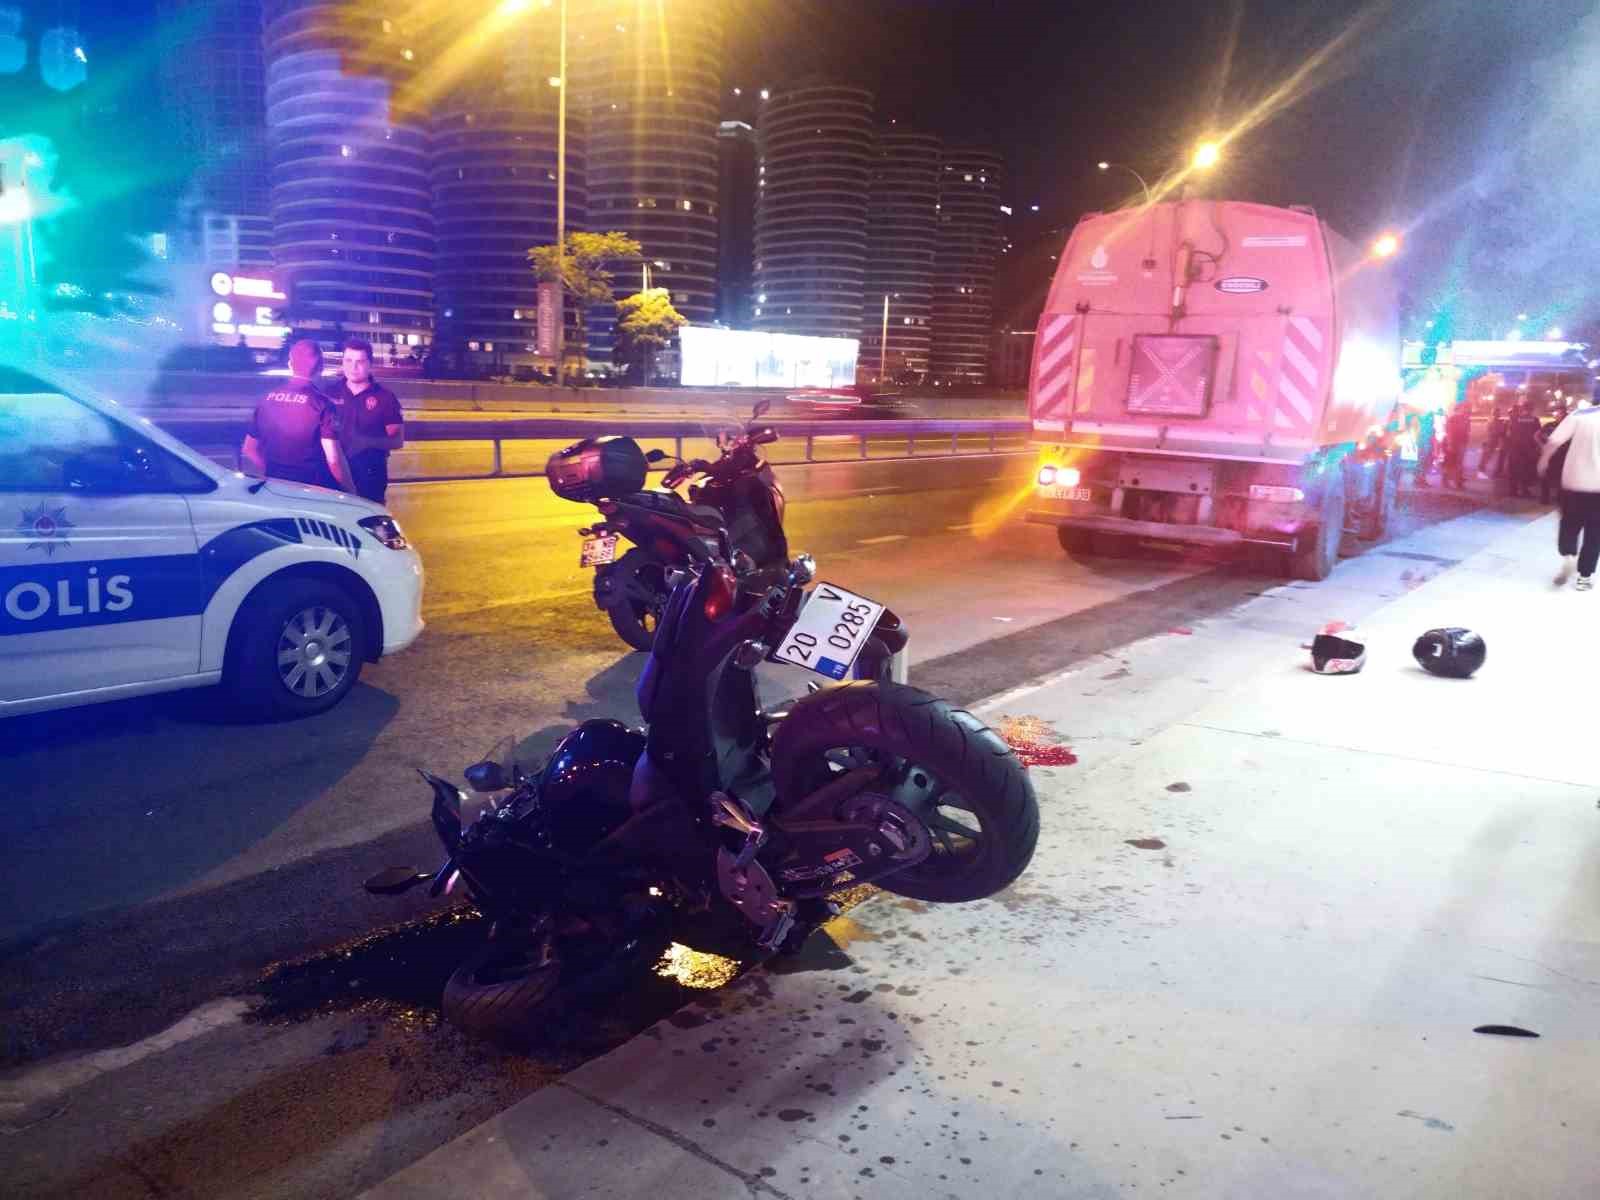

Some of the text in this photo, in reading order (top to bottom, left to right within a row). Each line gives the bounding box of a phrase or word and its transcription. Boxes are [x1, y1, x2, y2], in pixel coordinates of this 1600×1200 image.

[0, 566, 134, 621] OLİS
[786, 587, 843, 661] 20 V
[828, 600, 872, 650] 0285
